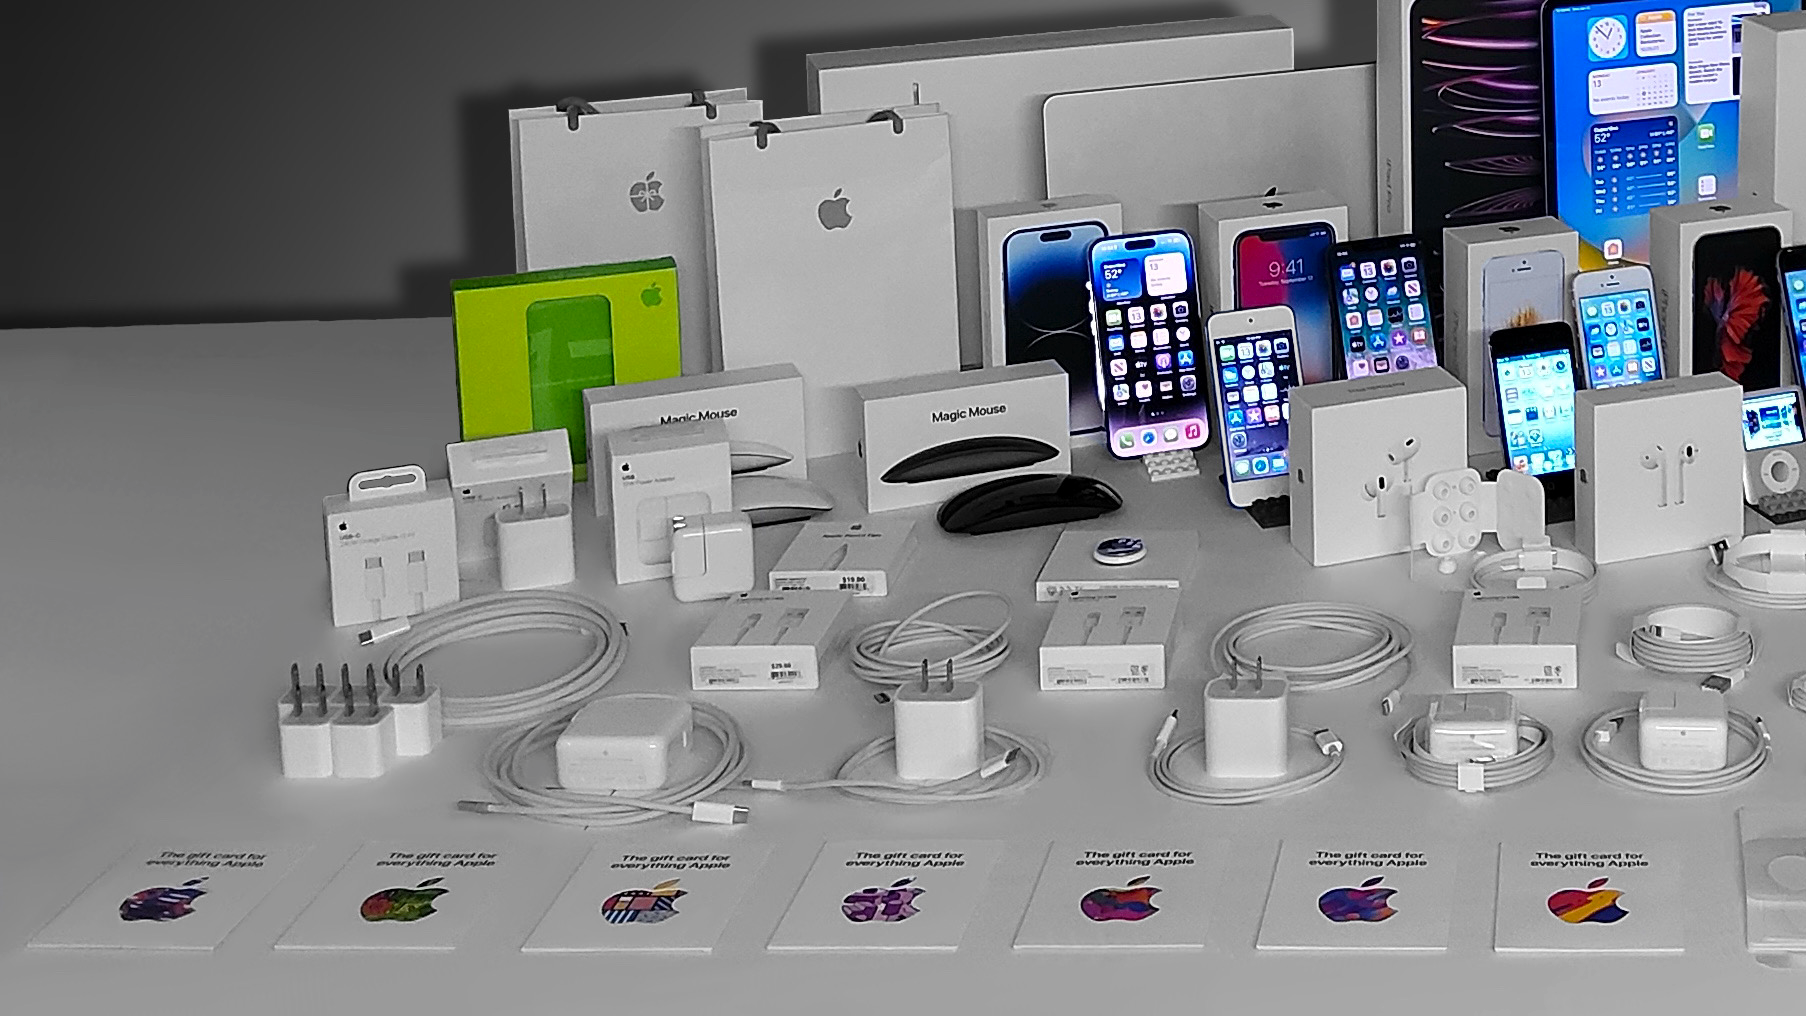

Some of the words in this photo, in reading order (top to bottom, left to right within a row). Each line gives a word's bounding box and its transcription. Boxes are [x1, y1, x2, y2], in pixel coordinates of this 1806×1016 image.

[1593, 79, 1602, 88] 13
[1268, 258, 1303, 278] 9:41
[1132, 312, 1141, 321] 13
[698, 408, 738, 421] Mouse
[931, 408, 967, 424] Magic
[968, 403, 1007, 417] Mouse
[416, 852, 441, 860] gift
[857, 851, 881, 859] The
[883, 852, 908, 860] gift
[1112, 851, 1136, 859] gift
[1344, 851, 1368, 859] gift
[1564, 852, 1587, 860] gift
[222, 860, 264, 868] Apple
[453, 859, 496, 867] Apple
[688, 862, 731, 870] Apple
[923, 859, 965, 867] Apple
[1153, 858, 1195, 866] Apple
[1308, 859, 1384, 867] everything
[1386, 859, 1428, 867] Apple
[1530, 860, 1605, 868] everything
[1607, 860, 1649, 868] Apple
